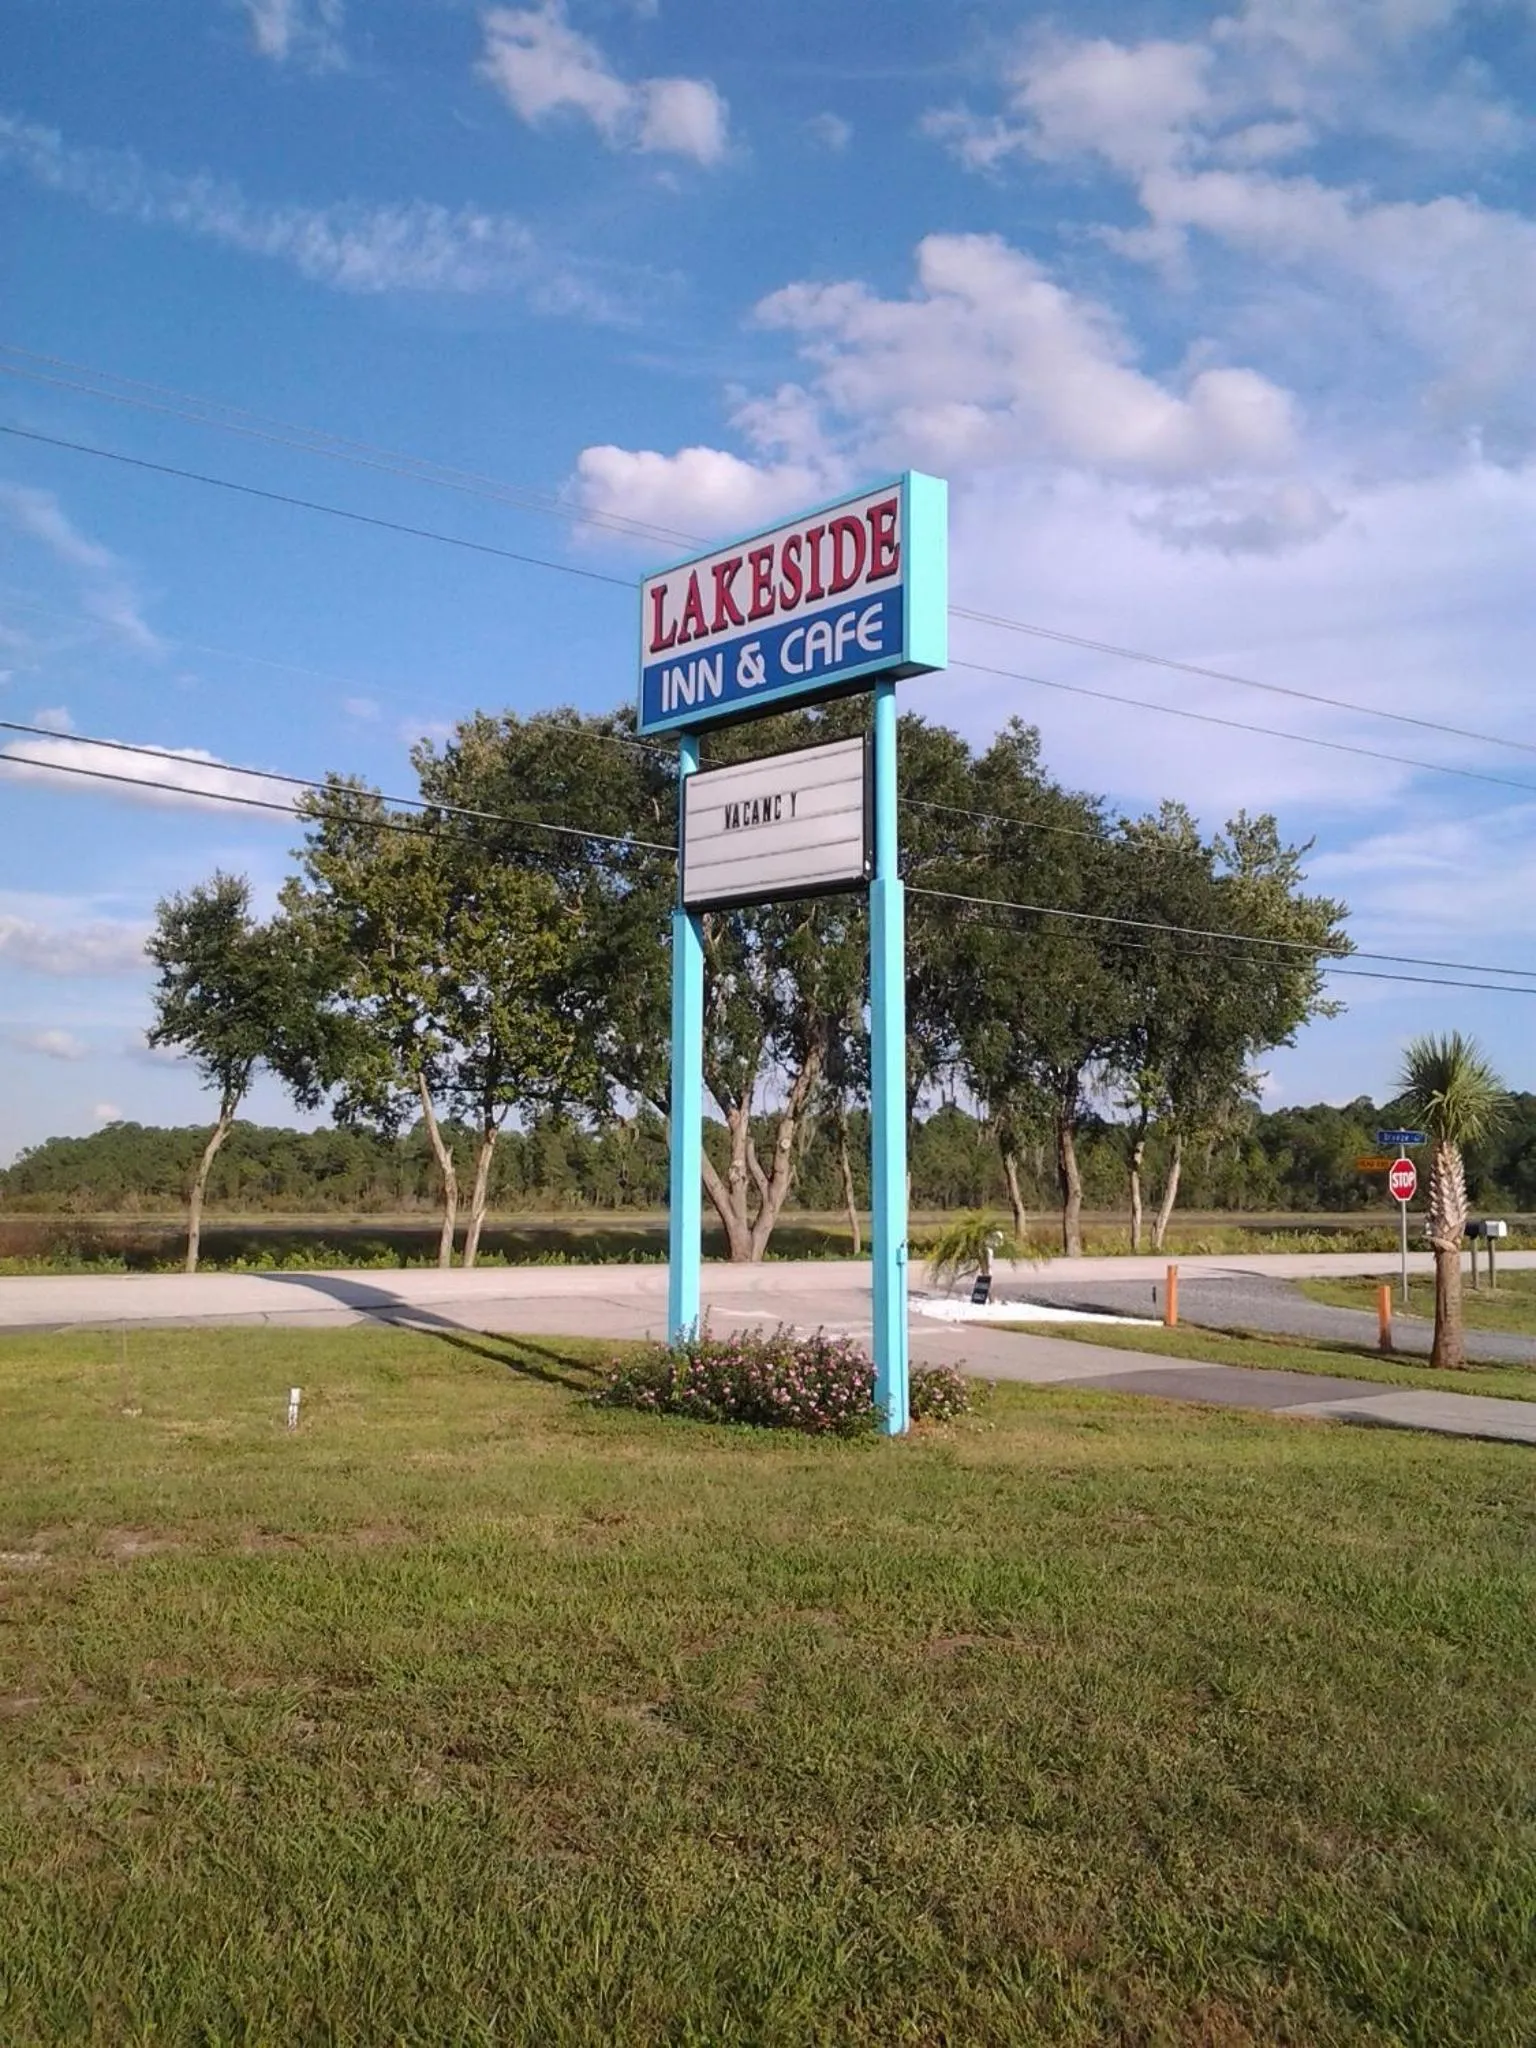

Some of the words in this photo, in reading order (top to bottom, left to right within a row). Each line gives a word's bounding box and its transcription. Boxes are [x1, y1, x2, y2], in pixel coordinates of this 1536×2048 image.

[650, 497, 900, 653] LAKESIDE
[661, 653, 723, 713] INN
[736, 641, 766, 689] &
[780, 602, 883, 675] CAFE
[1392, 1172, 1414, 1188] STOP
